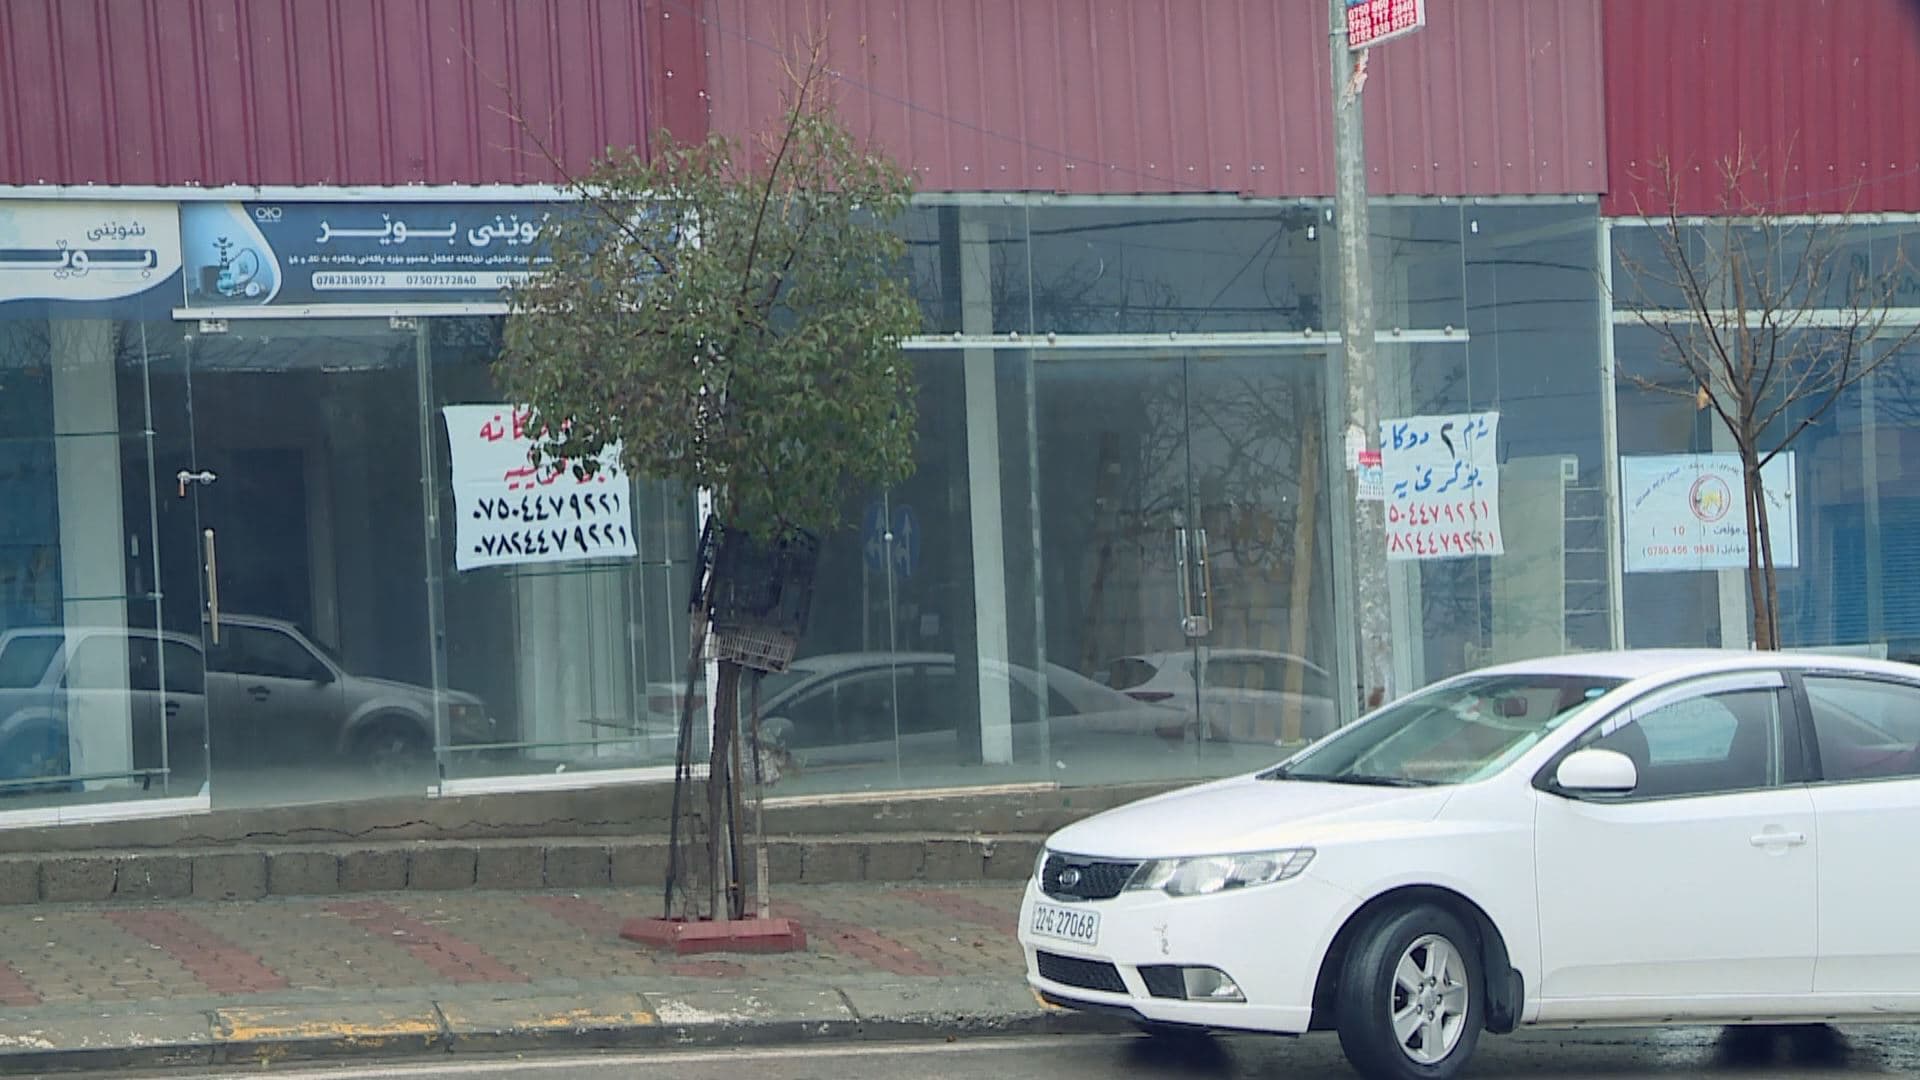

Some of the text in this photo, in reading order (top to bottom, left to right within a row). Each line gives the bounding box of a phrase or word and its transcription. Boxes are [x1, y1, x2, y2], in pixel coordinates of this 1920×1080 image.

[473, 493, 620, 522] ٠٧٥٠٤٤٧٩٢٢١
[1388, 500, 1489, 526] ٥٠٤٤٧٩٢٢١
[474, 523, 627, 556] ٠٧٨٢٤٤٧٩٢٢١
[1056, 910, 1095, 940] 27068
